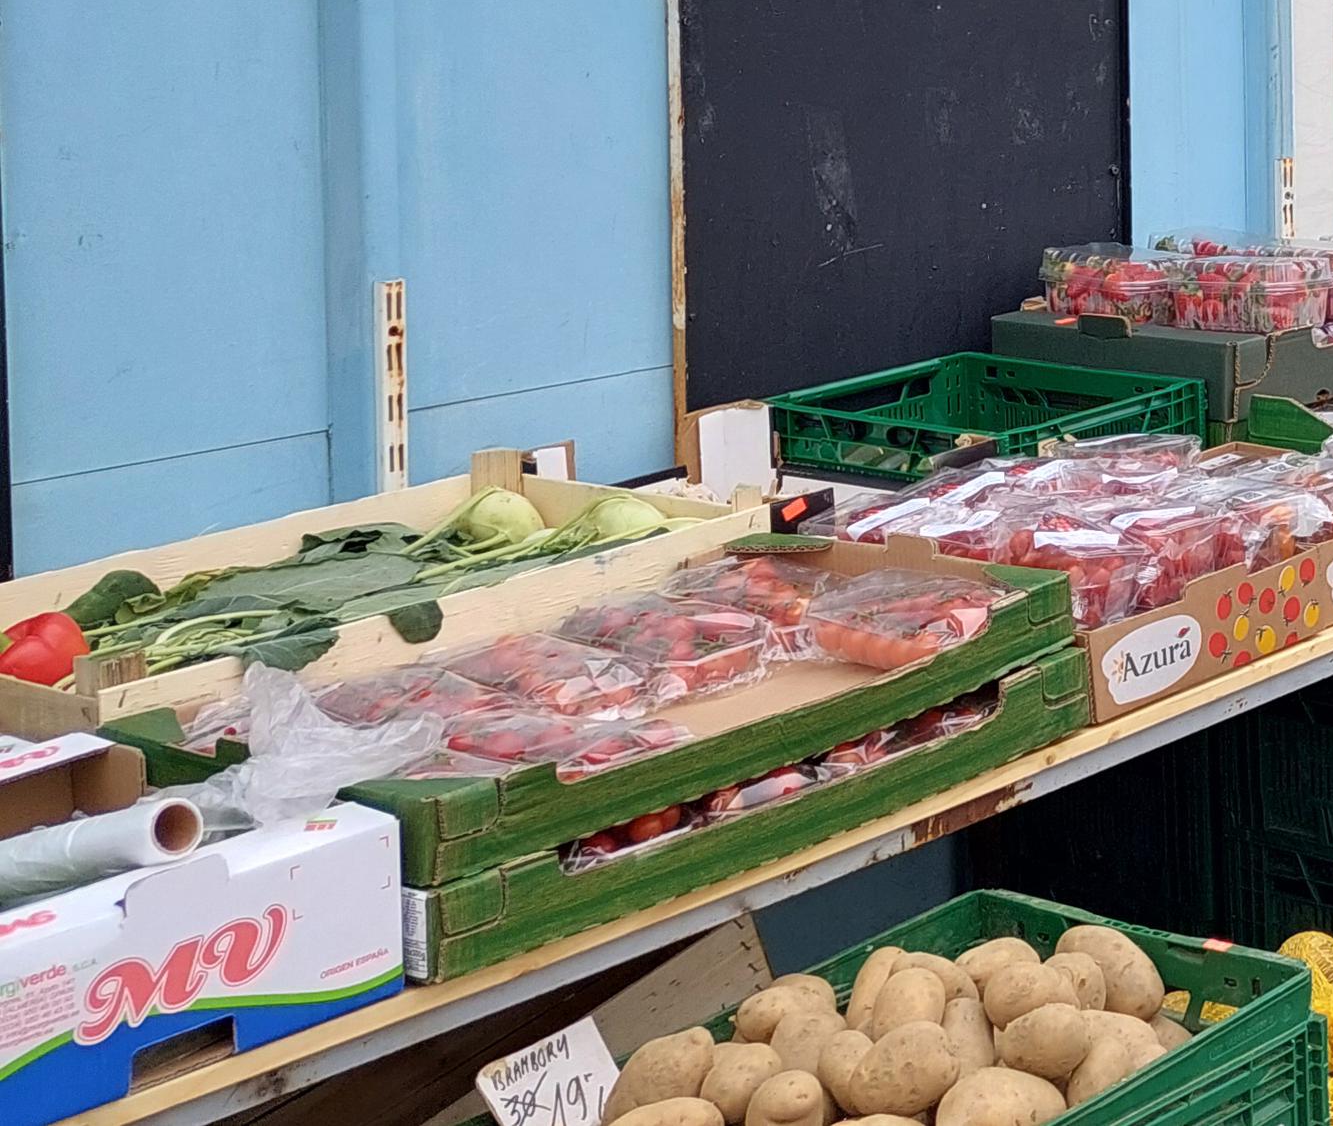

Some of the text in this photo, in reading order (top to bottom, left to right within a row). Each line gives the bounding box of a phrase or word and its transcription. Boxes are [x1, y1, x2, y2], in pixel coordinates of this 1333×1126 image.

[1121, 636, 1193, 682] Azura
[0, 965, 66, 997] rgiverde
[320, 948, 389, 979] ORIGEN ESPAÑA
[490, 1034, 569, 1091] BRAMBORY
